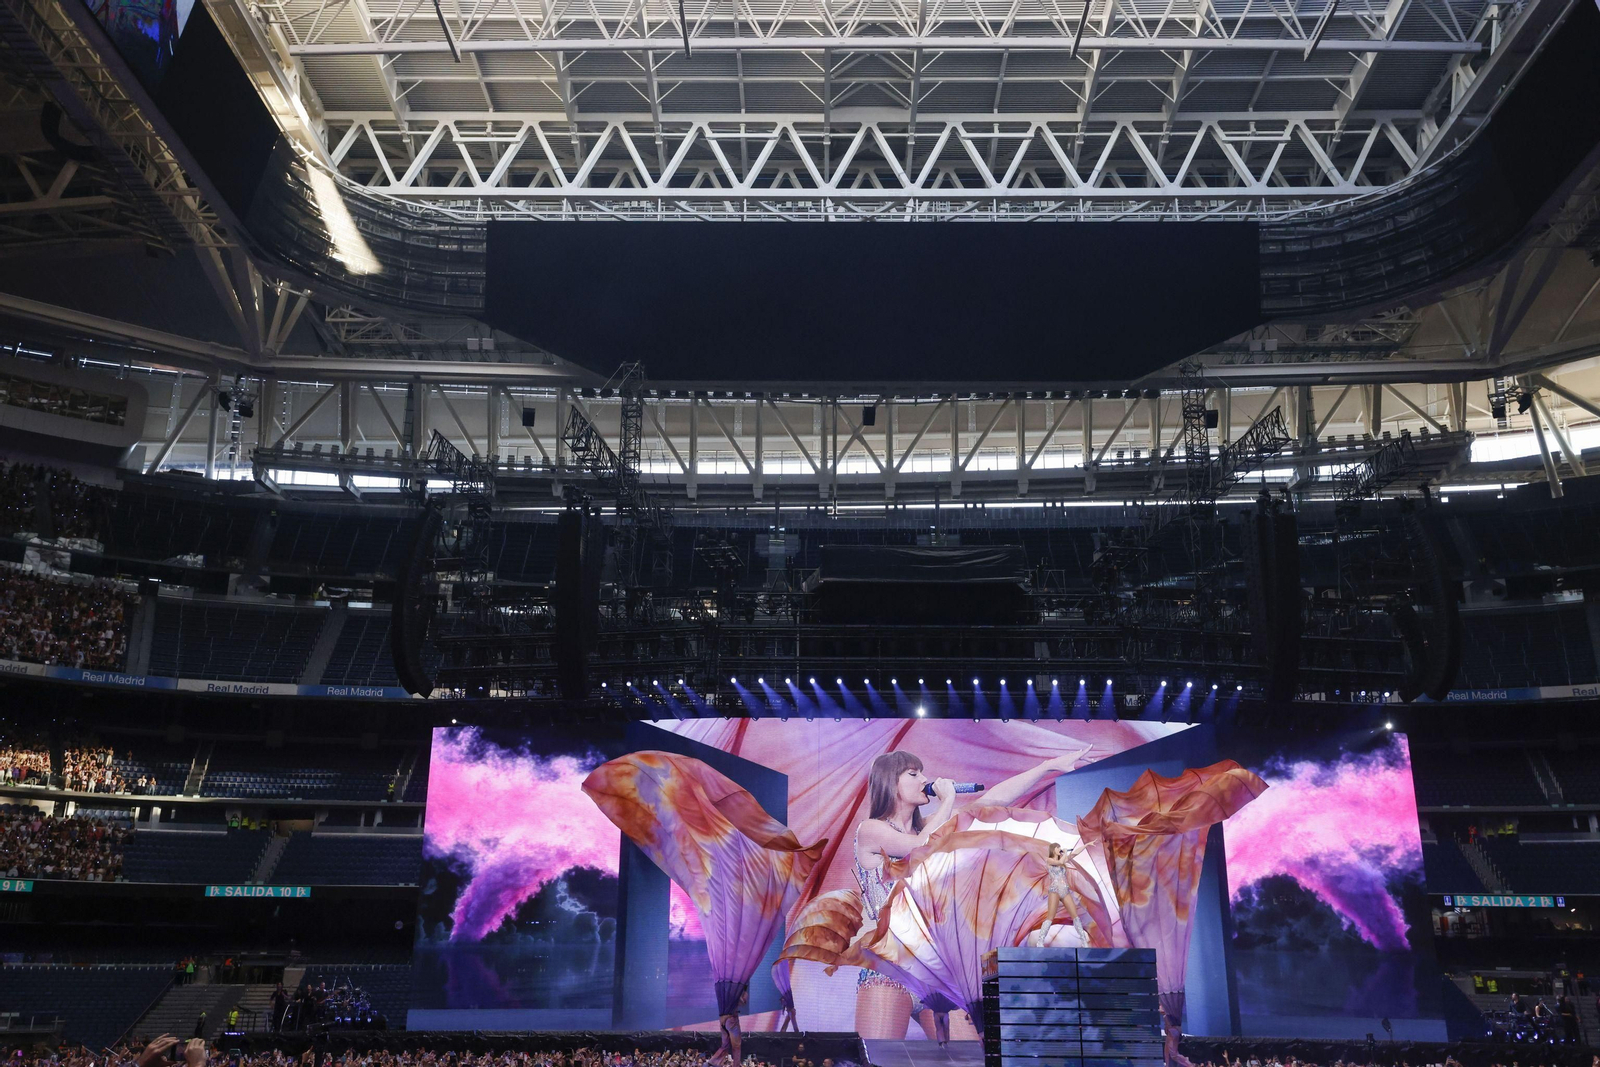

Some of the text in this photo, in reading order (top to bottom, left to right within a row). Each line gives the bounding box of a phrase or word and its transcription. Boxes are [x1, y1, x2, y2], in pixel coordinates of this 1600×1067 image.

[0, 663, 28, 674] adrid
[82, 671, 145, 686] Real Madrid
[207, 683, 270, 694] Real Madrid
[326, 686, 383, 697] Real Madrid
[1572, 686, 1598, 697] Real
[1447, 690, 1508, 700] Real Madrid
[2, 880, 10, 891] 9
[224, 886, 292, 897] SALIDA 10
[1471, 895, 1536, 907] SALIDA 2
